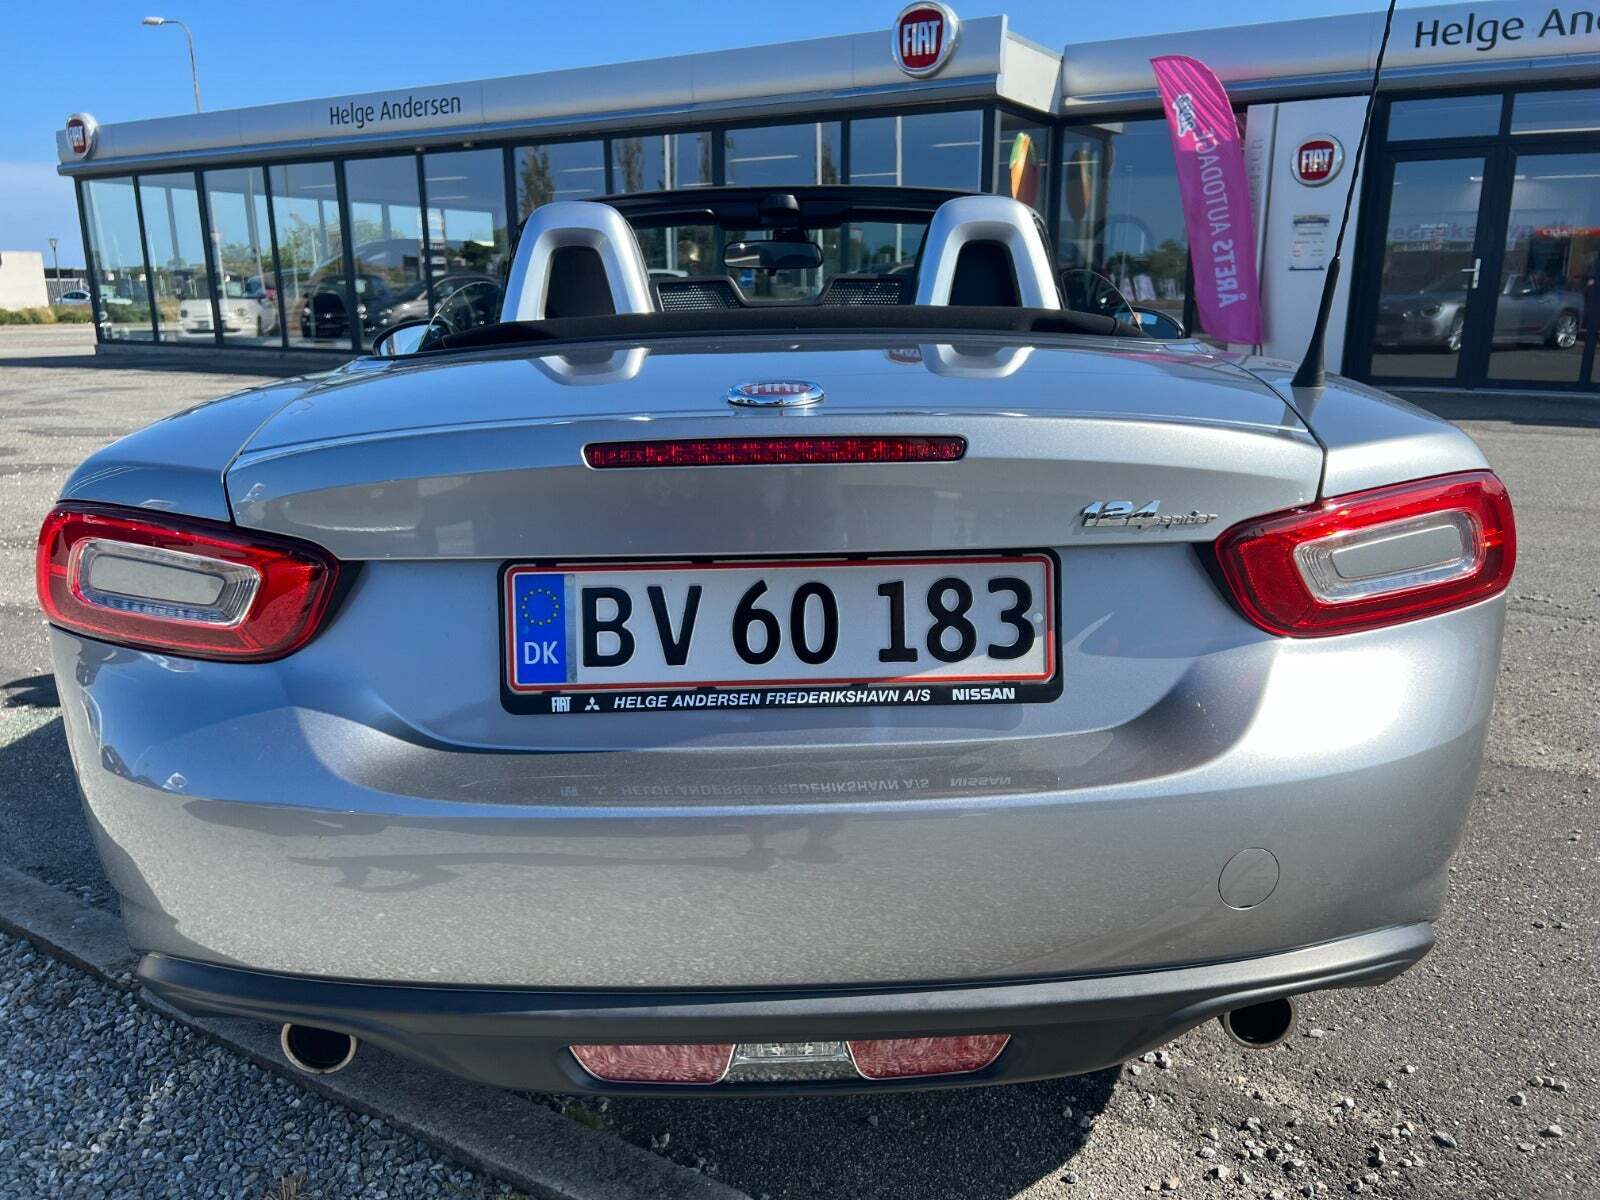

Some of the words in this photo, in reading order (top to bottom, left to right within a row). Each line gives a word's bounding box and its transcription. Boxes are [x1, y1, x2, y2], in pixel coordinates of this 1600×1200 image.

[902, 20, 941, 57] FIAT
[1415, 12, 1525, 51] Helge
[1538, 8, 1600, 38] An
[329, 102, 375, 129] Helge
[380, 96, 461, 120] Andersen
[1301, 148, 1333, 173] FIAT
[1081, 500, 1160, 529] 124
[582, 585, 703, 667] BV
[732, 579, 839, 665] 60
[877, 576, 1036, 663] 183
[524, 641, 559, 665] DK
[551, 697, 572, 713] FIAT
[614, 695, 668, 709] HELGE
[672, 692, 761, 708] ANDERSEN
[766, 690, 899, 705] FREDERIKSHAVN
[903, 689, 931, 702] A/S
[952, 687, 1016, 701] NISSAN
